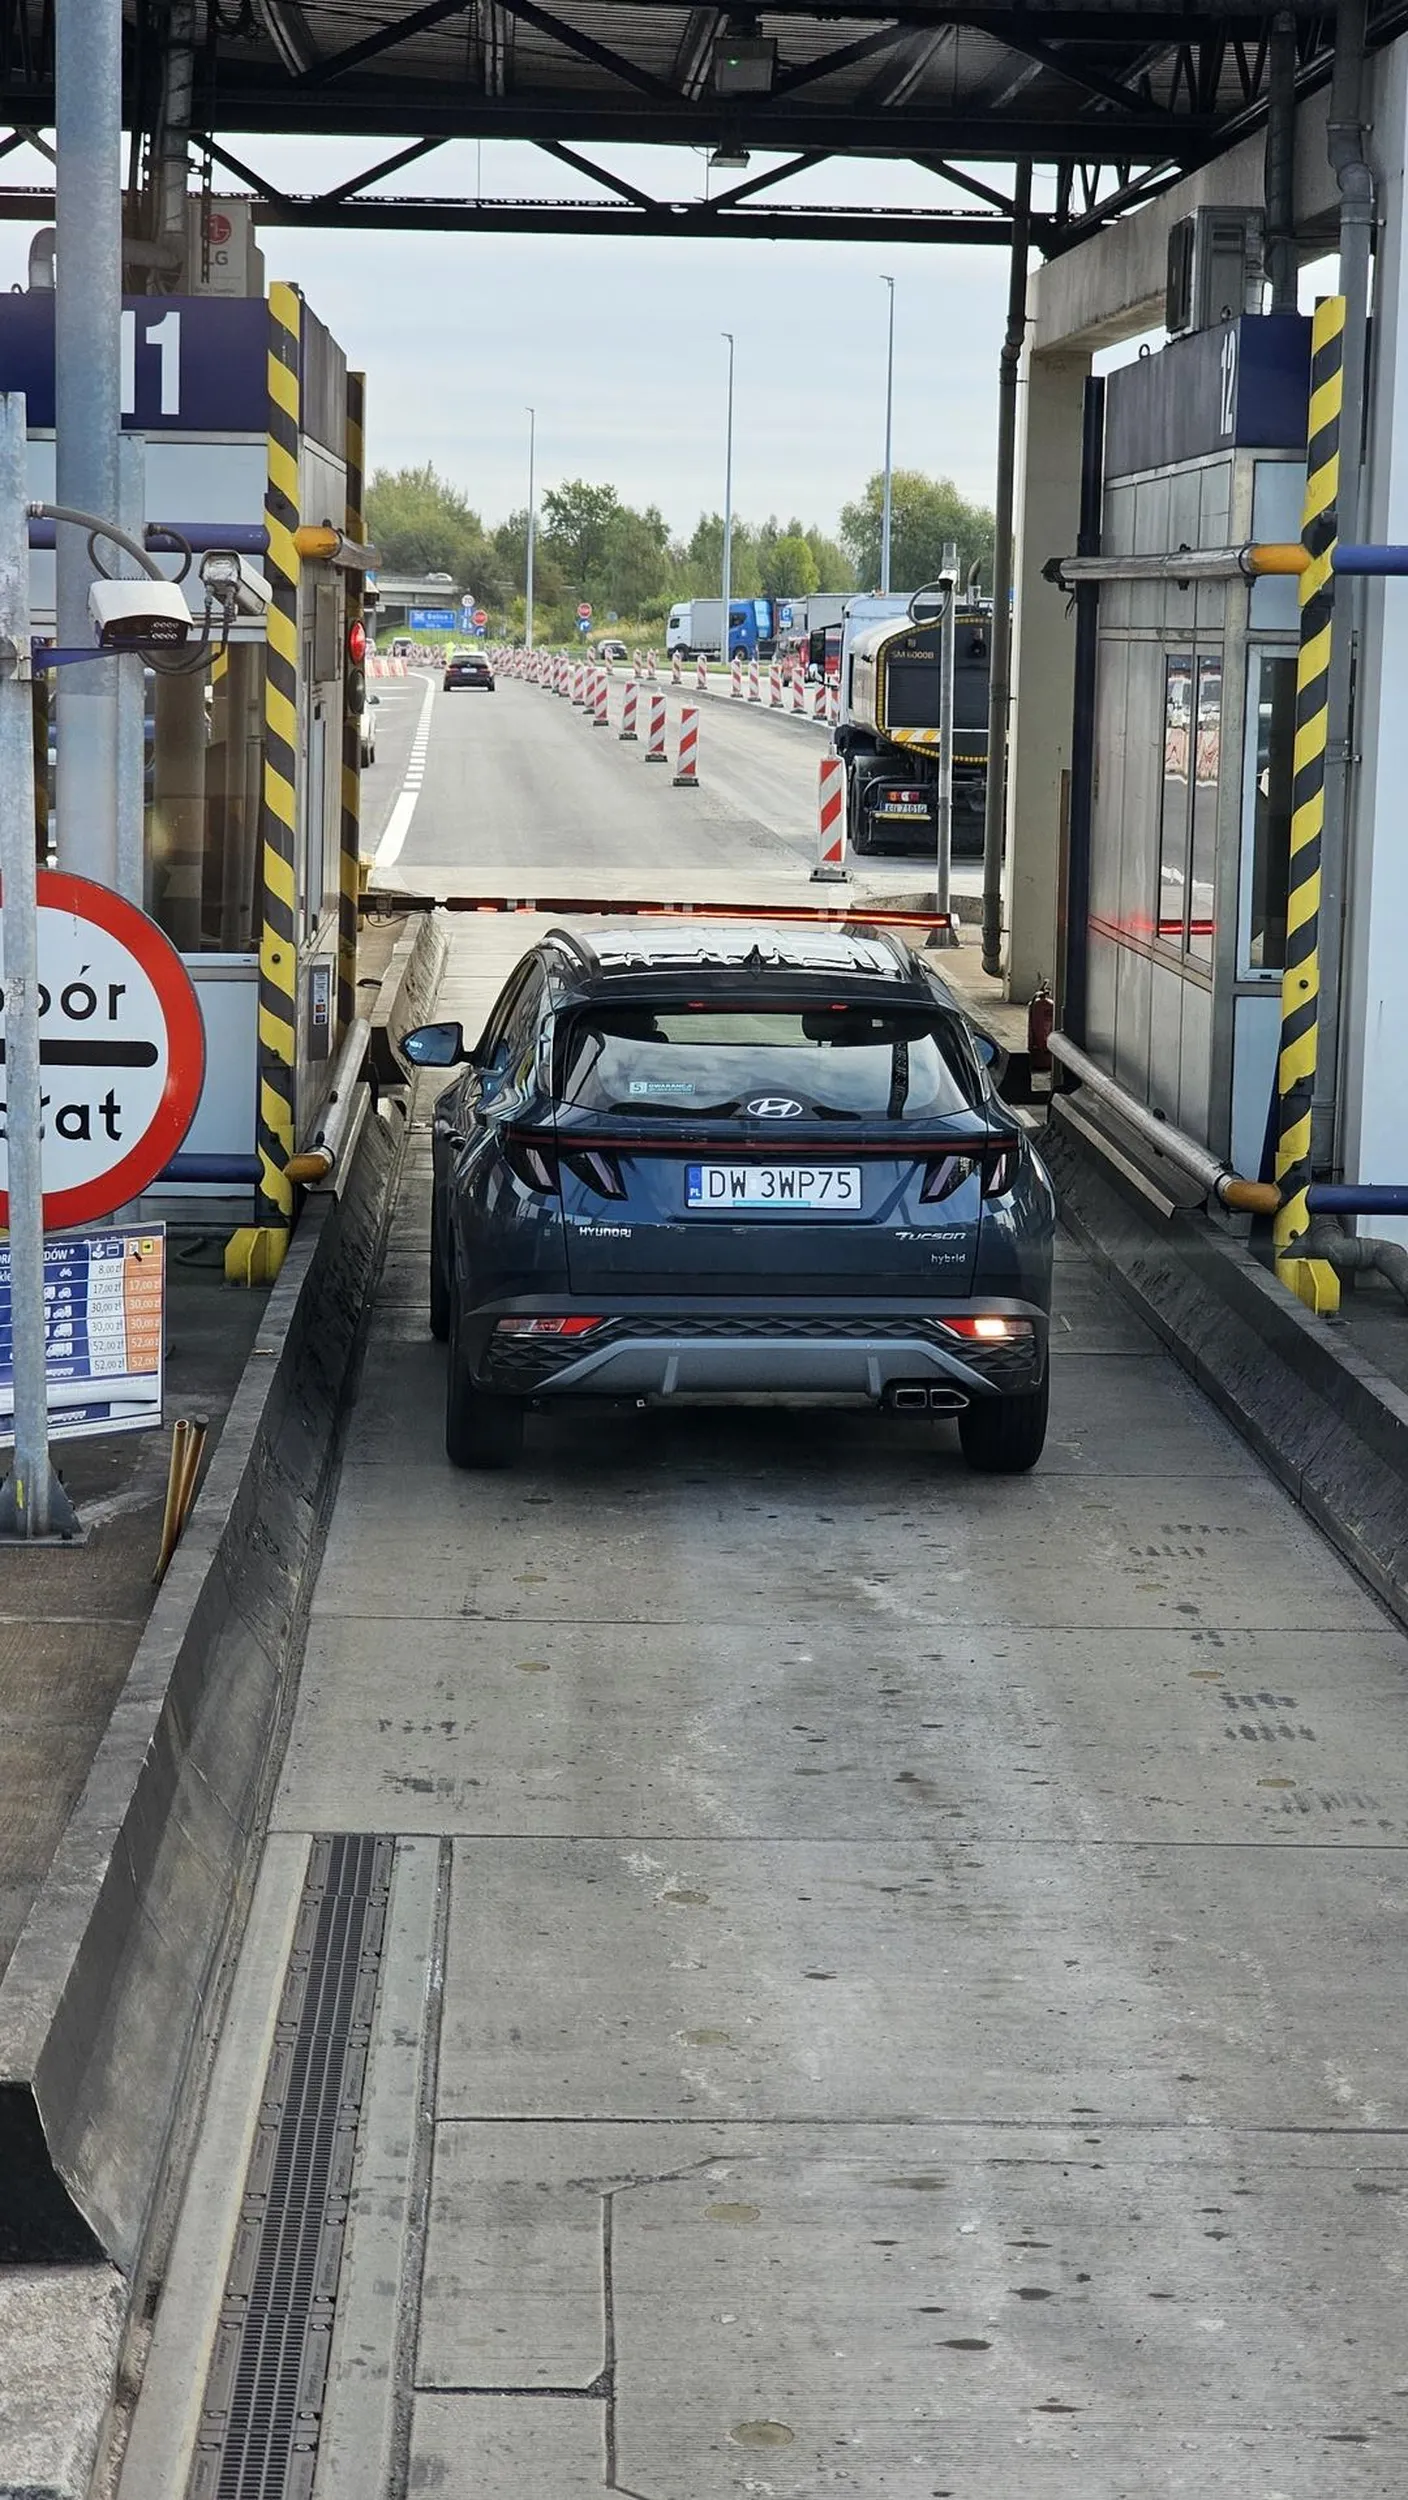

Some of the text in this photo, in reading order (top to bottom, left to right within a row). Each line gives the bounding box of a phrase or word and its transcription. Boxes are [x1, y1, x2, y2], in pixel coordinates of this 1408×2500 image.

[208, 251, 228, 266] G
[120, 310, 180, 415] 11
[1220, 330, 1236, 436] 12
[709, 1170, 852, 1199] DW 3WP75
[689, 1188, 701, 1197] PL
[579, 1226, 632, 1238] HYUNDAI
[931, 1253, 966, 1265] hybrid
[93, 1283, 113, 1294] 17,00
[91, 1302, 113, 1313] 30,00
[91, 1321, 114, 1333] 30,00
